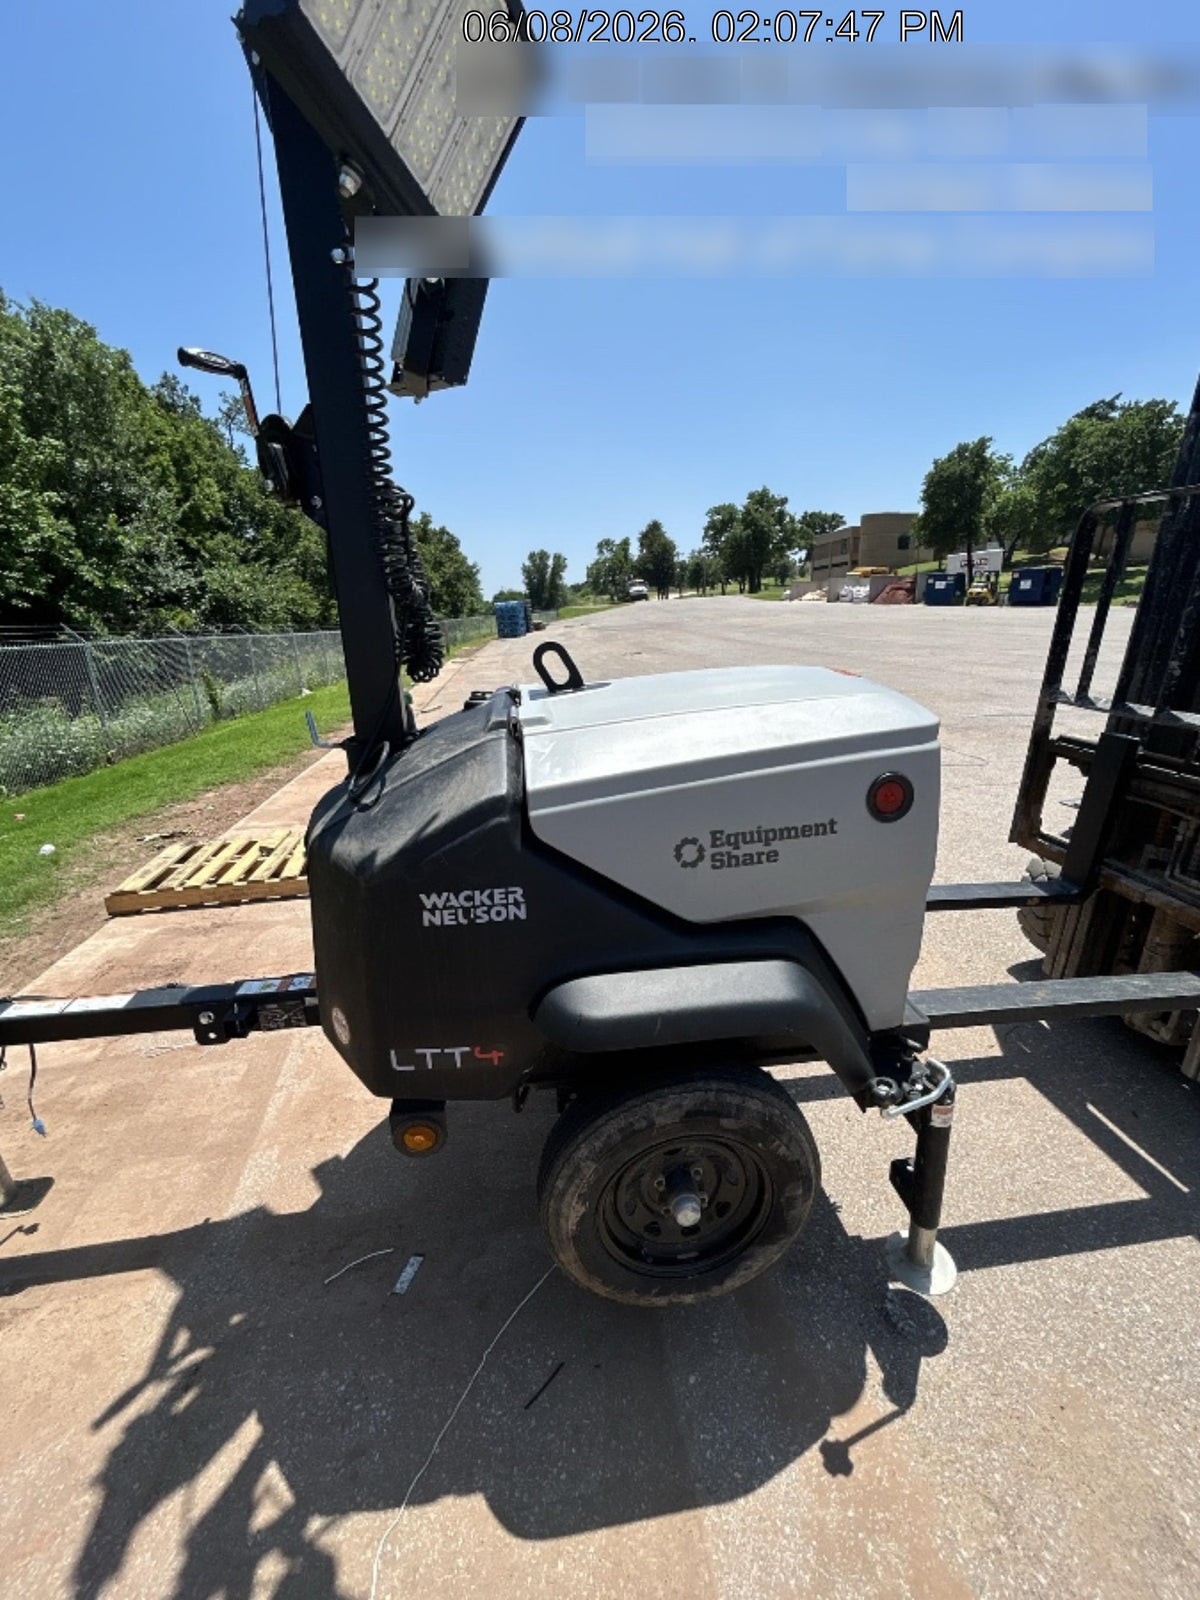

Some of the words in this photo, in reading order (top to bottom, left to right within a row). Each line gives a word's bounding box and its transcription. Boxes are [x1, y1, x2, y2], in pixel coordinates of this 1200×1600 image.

[709, 818, 838, 850] Equipment
[710, 850, 779, 870] Share
[419, 886, 525, 909] WACKER
